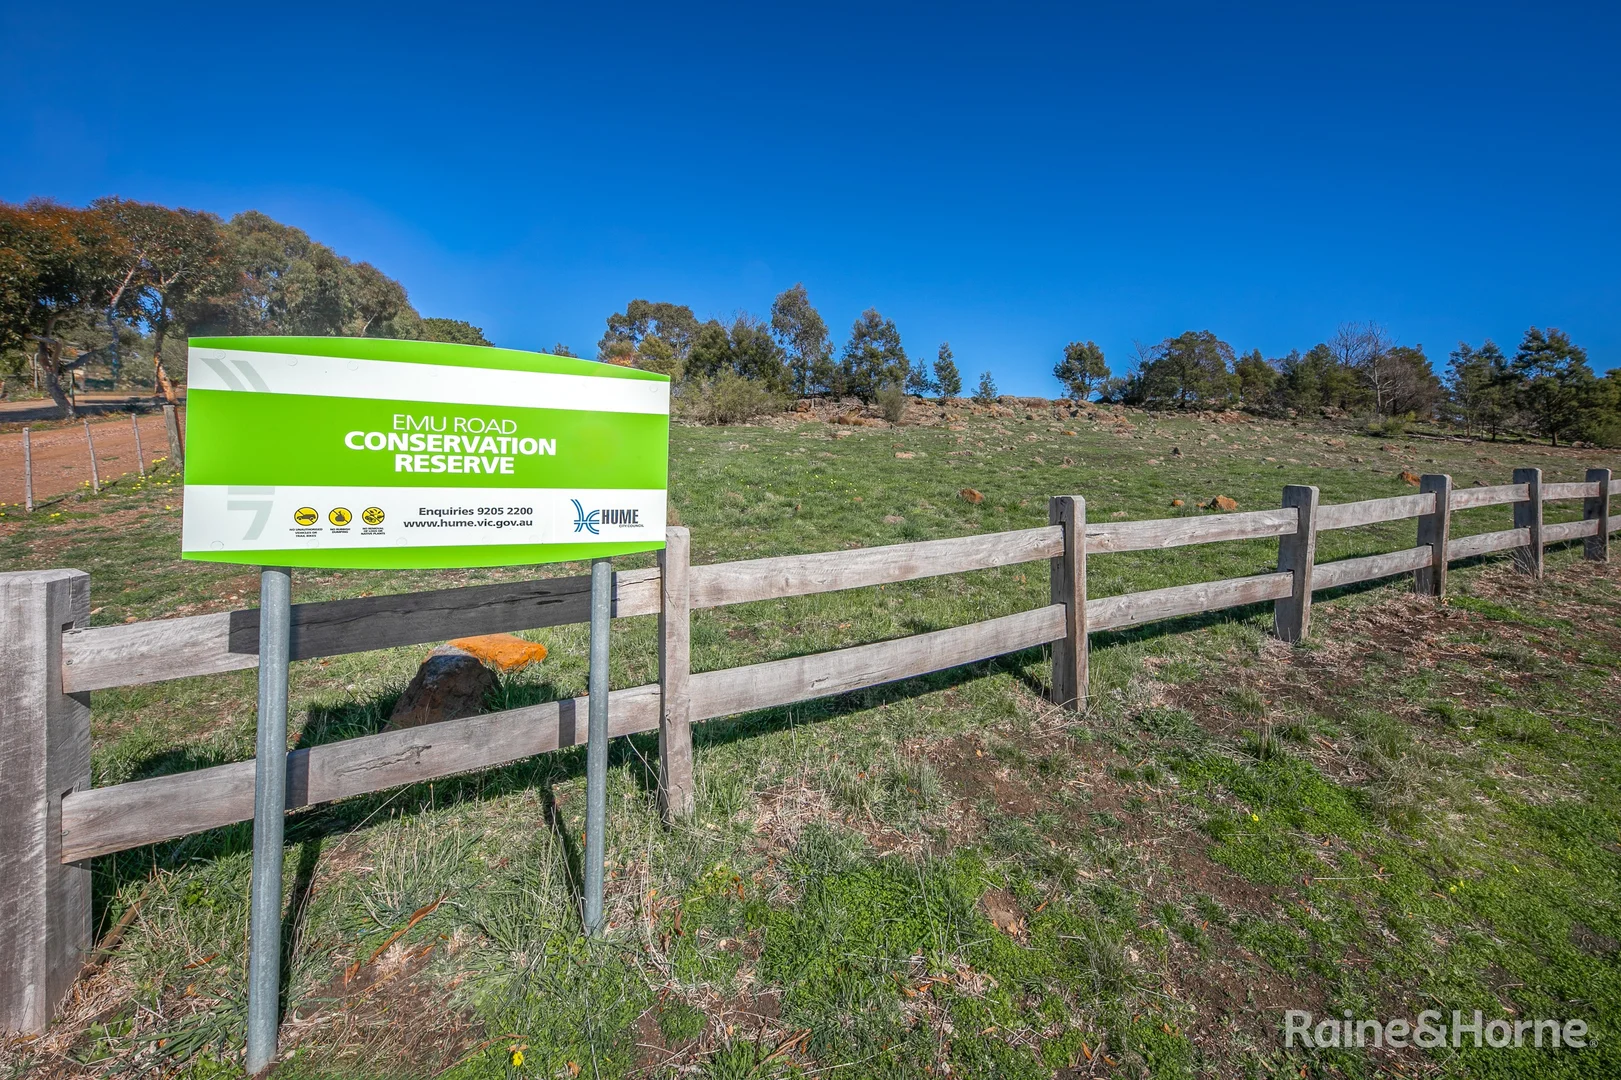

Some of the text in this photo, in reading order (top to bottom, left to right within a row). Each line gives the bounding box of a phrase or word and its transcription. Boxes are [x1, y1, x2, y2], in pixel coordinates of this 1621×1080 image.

[393, 414, 517, 434] EMU ROAD
[344, 431, 557, 455] CONSERVATION
[394, 454, 515, 474] RESERVE
[418, 507, 533, 517] Enquiries 9205 2200
[601, 509, 639, 524] HUME
[403, 519, 533, 529] www.hume.vic.gov.au
